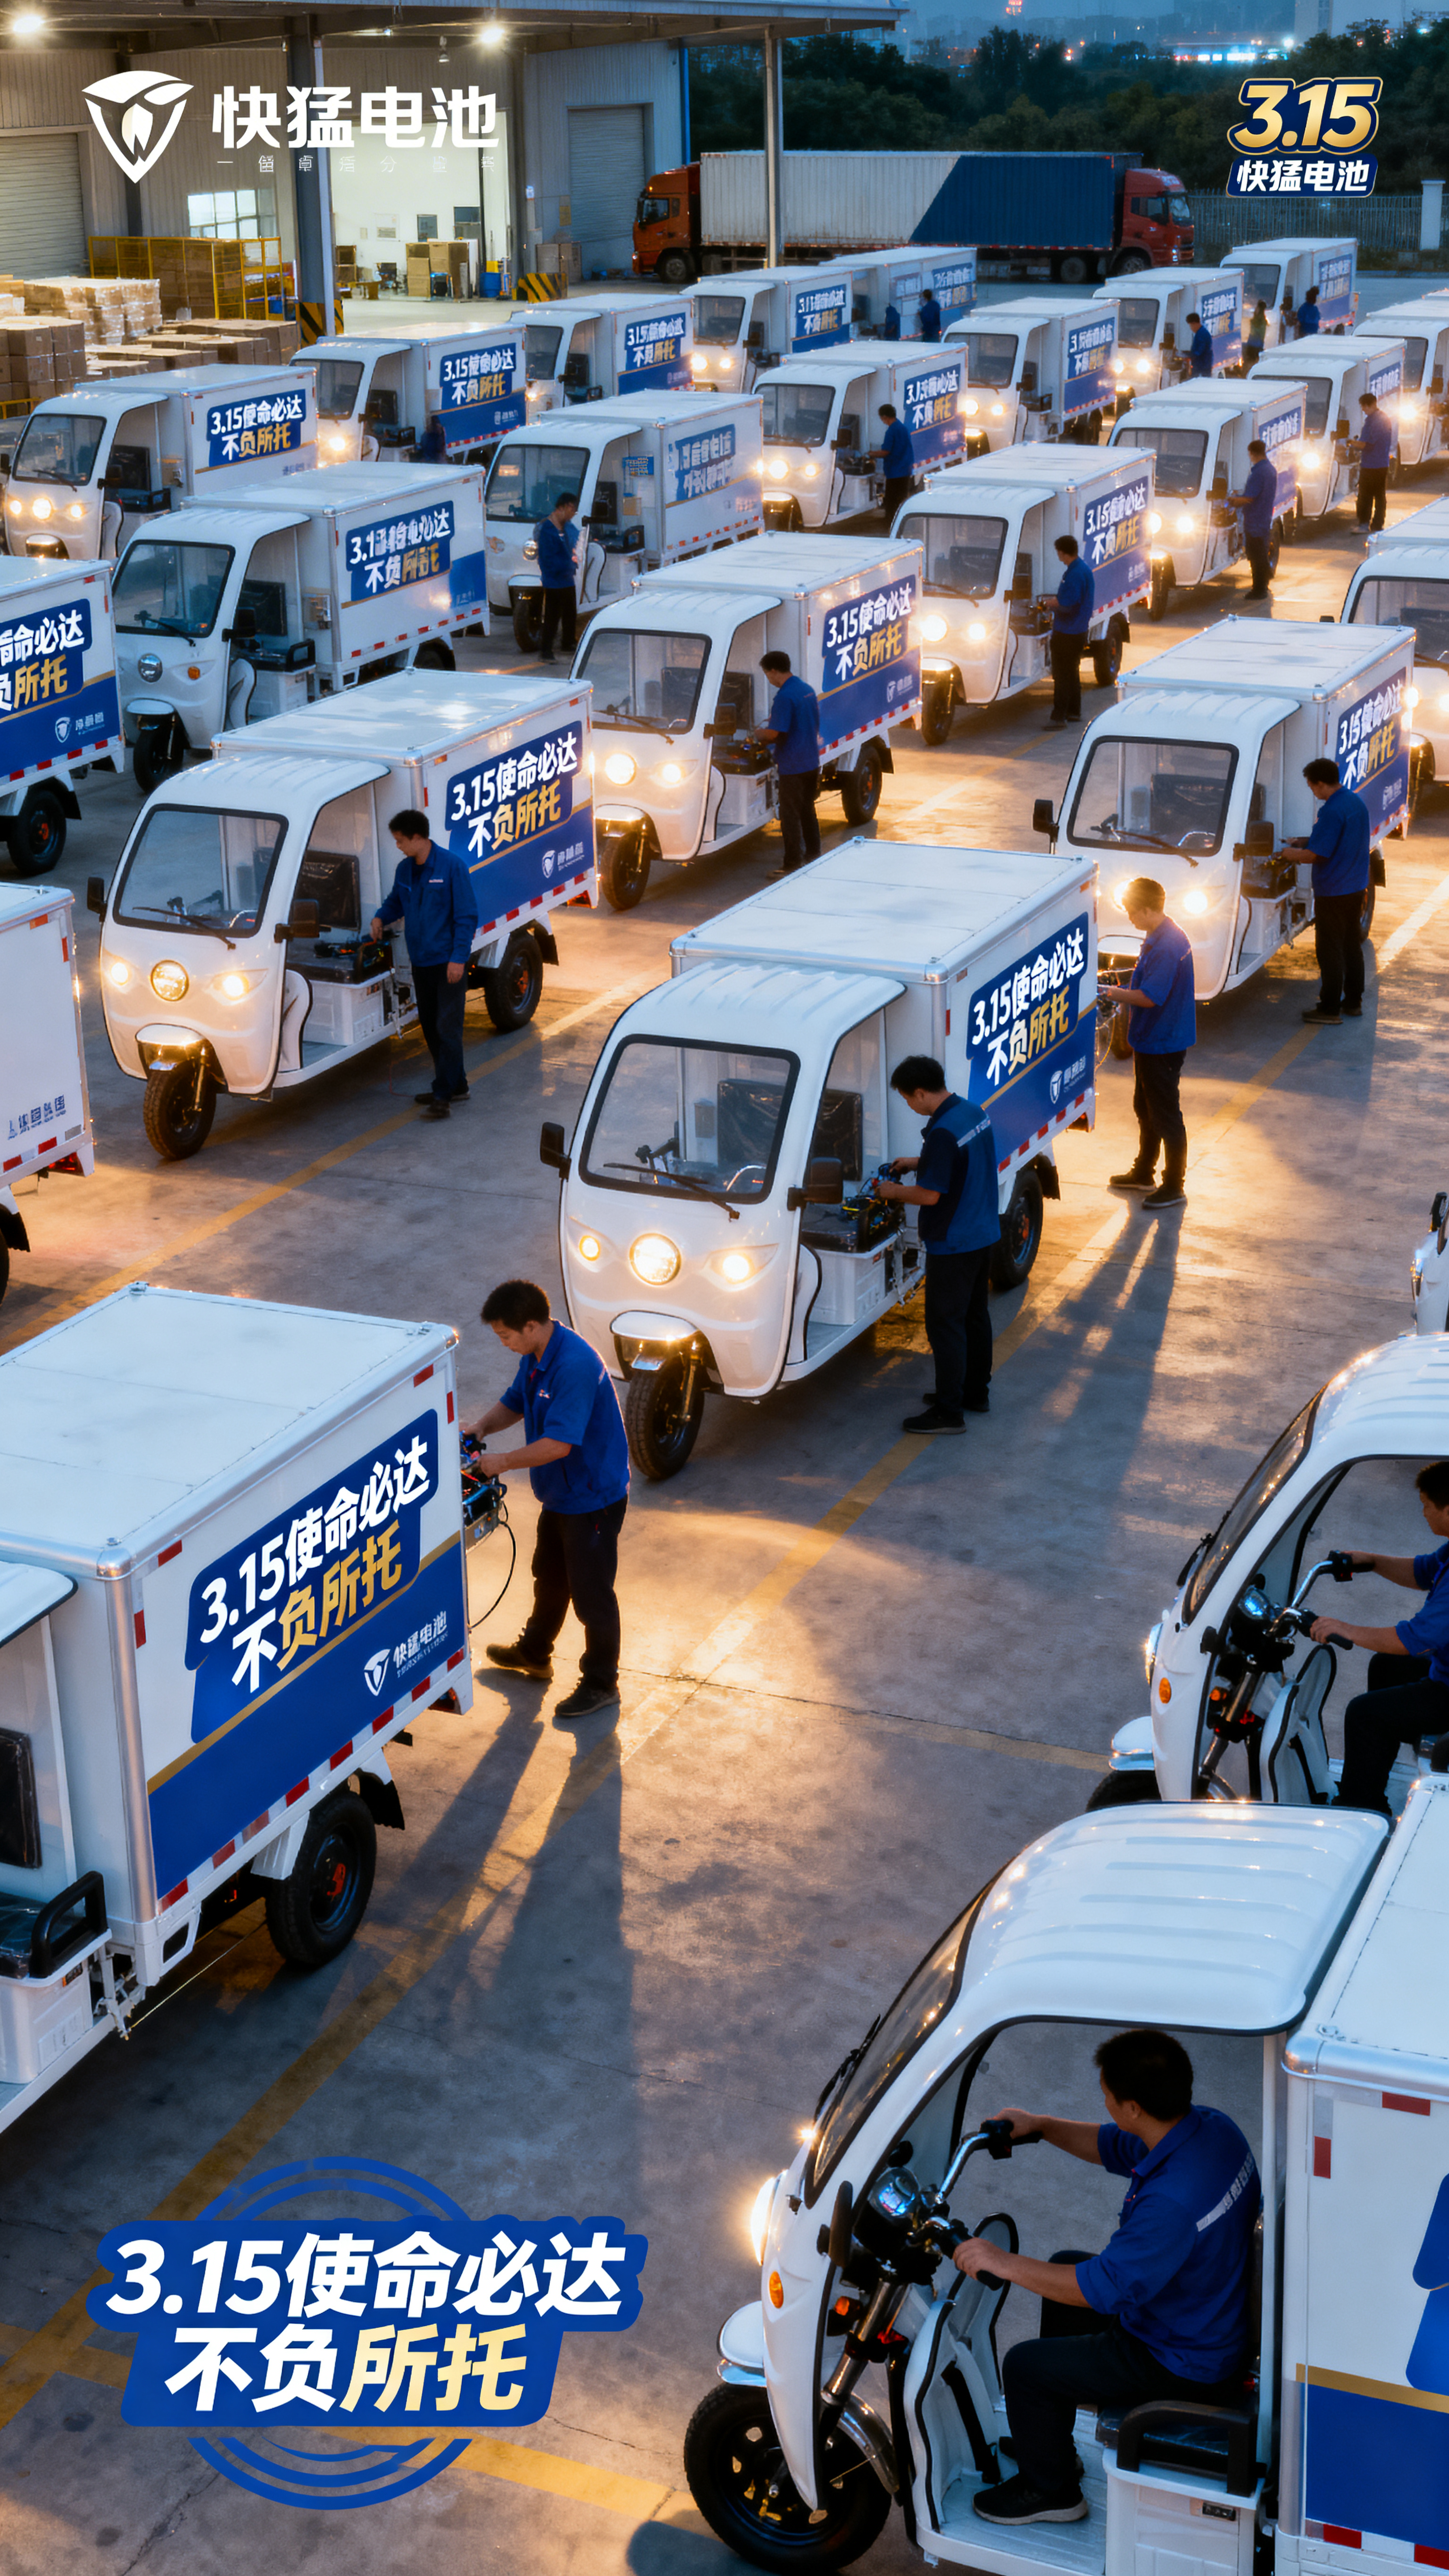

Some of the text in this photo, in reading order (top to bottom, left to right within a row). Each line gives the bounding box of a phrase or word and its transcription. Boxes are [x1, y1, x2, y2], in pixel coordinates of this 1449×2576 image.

[222, 422, 291, 460] 不负所托
[826, 584, 912, 647] 3.15使命必达
[835, 622, 902, 681] 不负所托
[451, 732, 578, 821] 3.15使命必达
[468, 779, 561, 858] 不负所托
[972, 928, 1084, 1045] 3.15使命必达
[986, 985, 1068, 1086] 不负所托
[200, 1435, 430, 1643] 3.15使命必达
[232, 1519, 402, 1693] 不负所托
